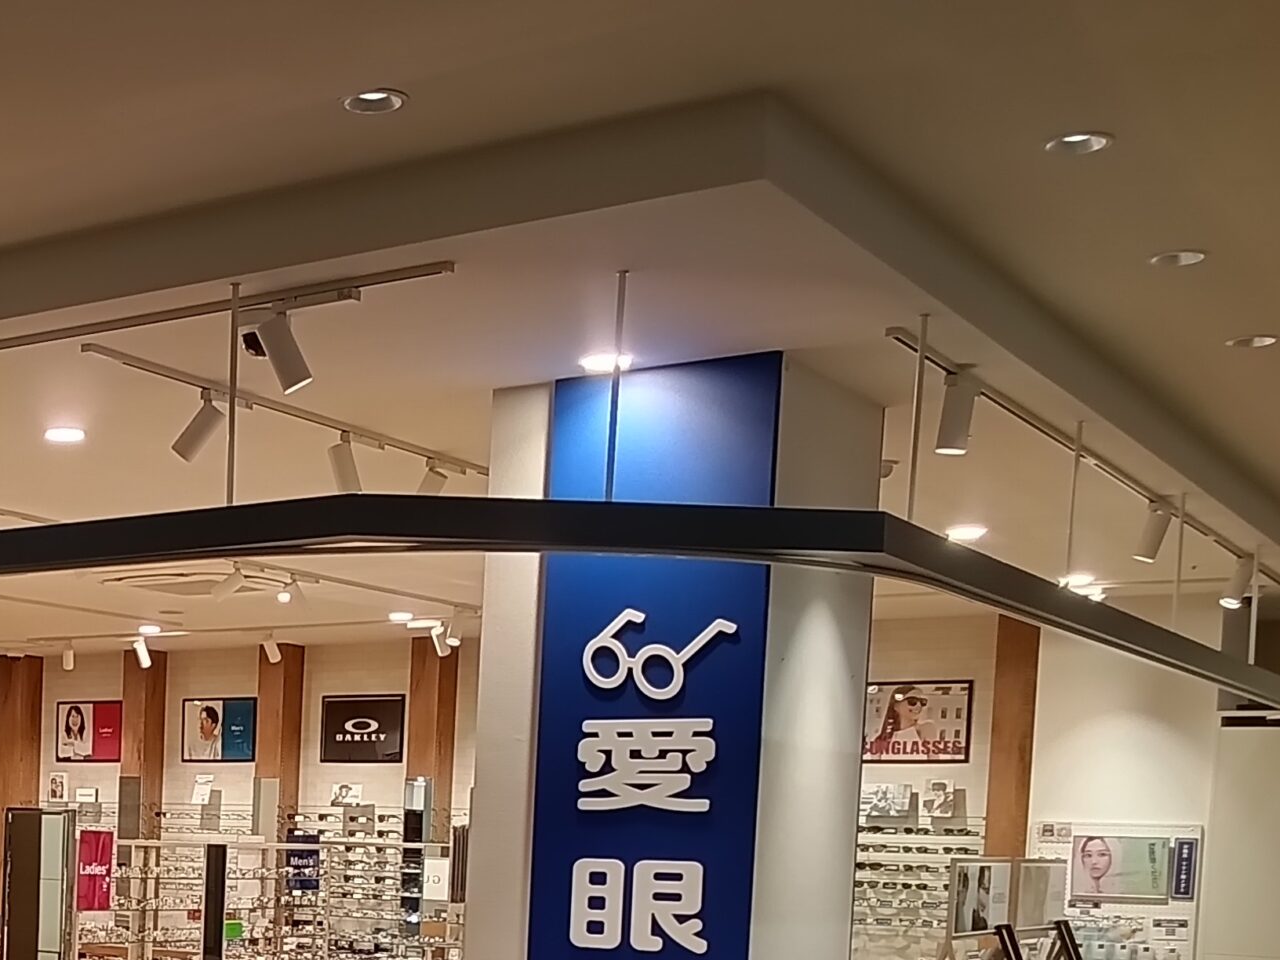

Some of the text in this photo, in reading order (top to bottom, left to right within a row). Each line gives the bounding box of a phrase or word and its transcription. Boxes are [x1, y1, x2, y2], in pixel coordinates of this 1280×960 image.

[335, 733, 387, 742] OAKLEY
[569, 717, 716, 955] 愛眼
[290, 856, 314, 866] Men's
